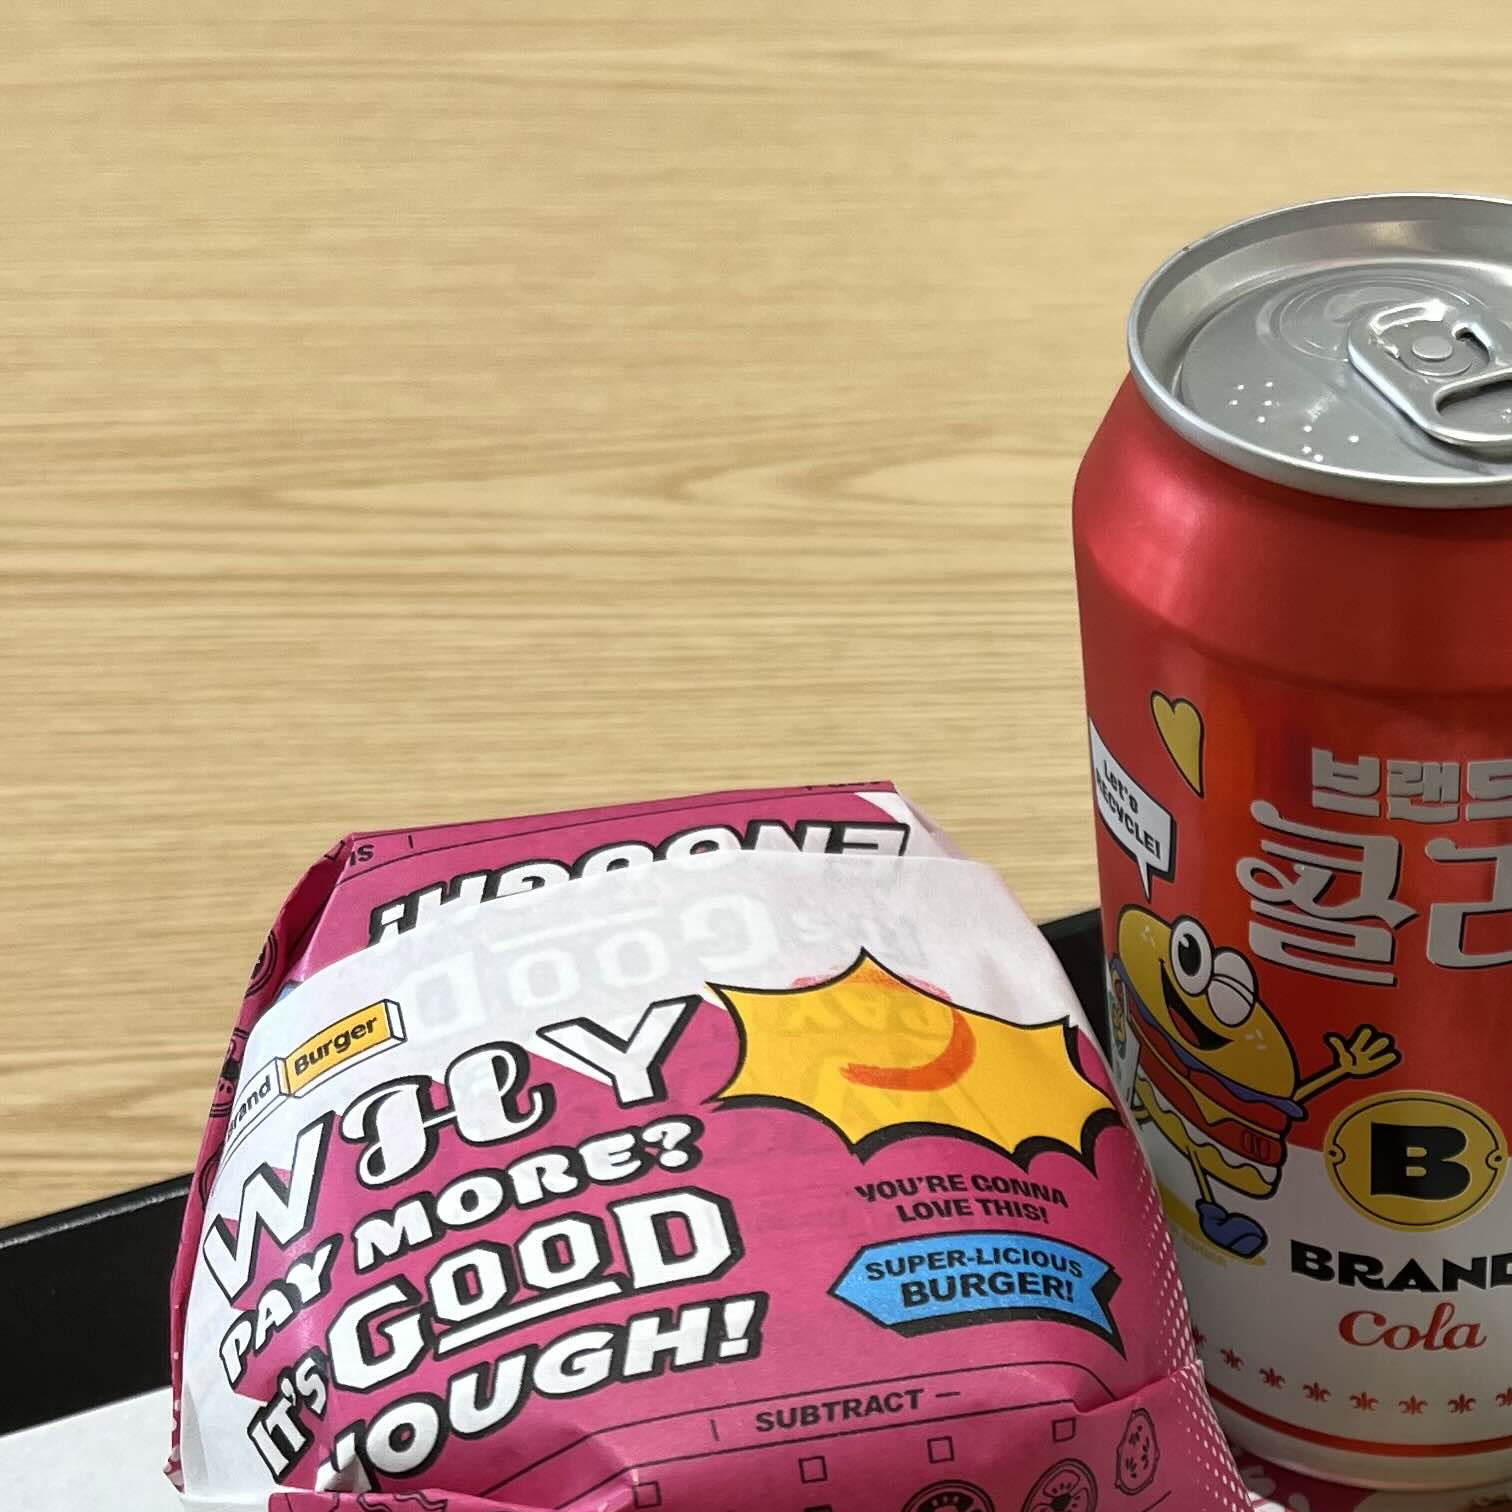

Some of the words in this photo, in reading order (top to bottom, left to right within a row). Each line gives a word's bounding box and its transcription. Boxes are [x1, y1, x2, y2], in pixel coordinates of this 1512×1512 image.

[226, 1075, 271, 1141] rand
[294, 1017, 378, 1076] Burger
[203, 994, 705, 1301] WHY
[1370, 1122, 1471, 1200] B
[855, 1174, 968, 1202] YOU'RE
[971, 1174, 1069, 1208] GONNA
[896, 1199, 973, 1223] LOVE
[976, 1198, 1049, 1224] THIS!
[219, 1233, 342, 1383] PAY
[352, 1114, 705, 1275] MORE?
[865, 1247, 1083, 1281] SUPER-LICIOUS
[327, 1187, 746, 1394] GOOD
[901, 1271, 1074, 1308] BURGER!
[1339, 1302, 1488, 1351] Cola
[755, 1388, 926, 1433] SUBTRACT
